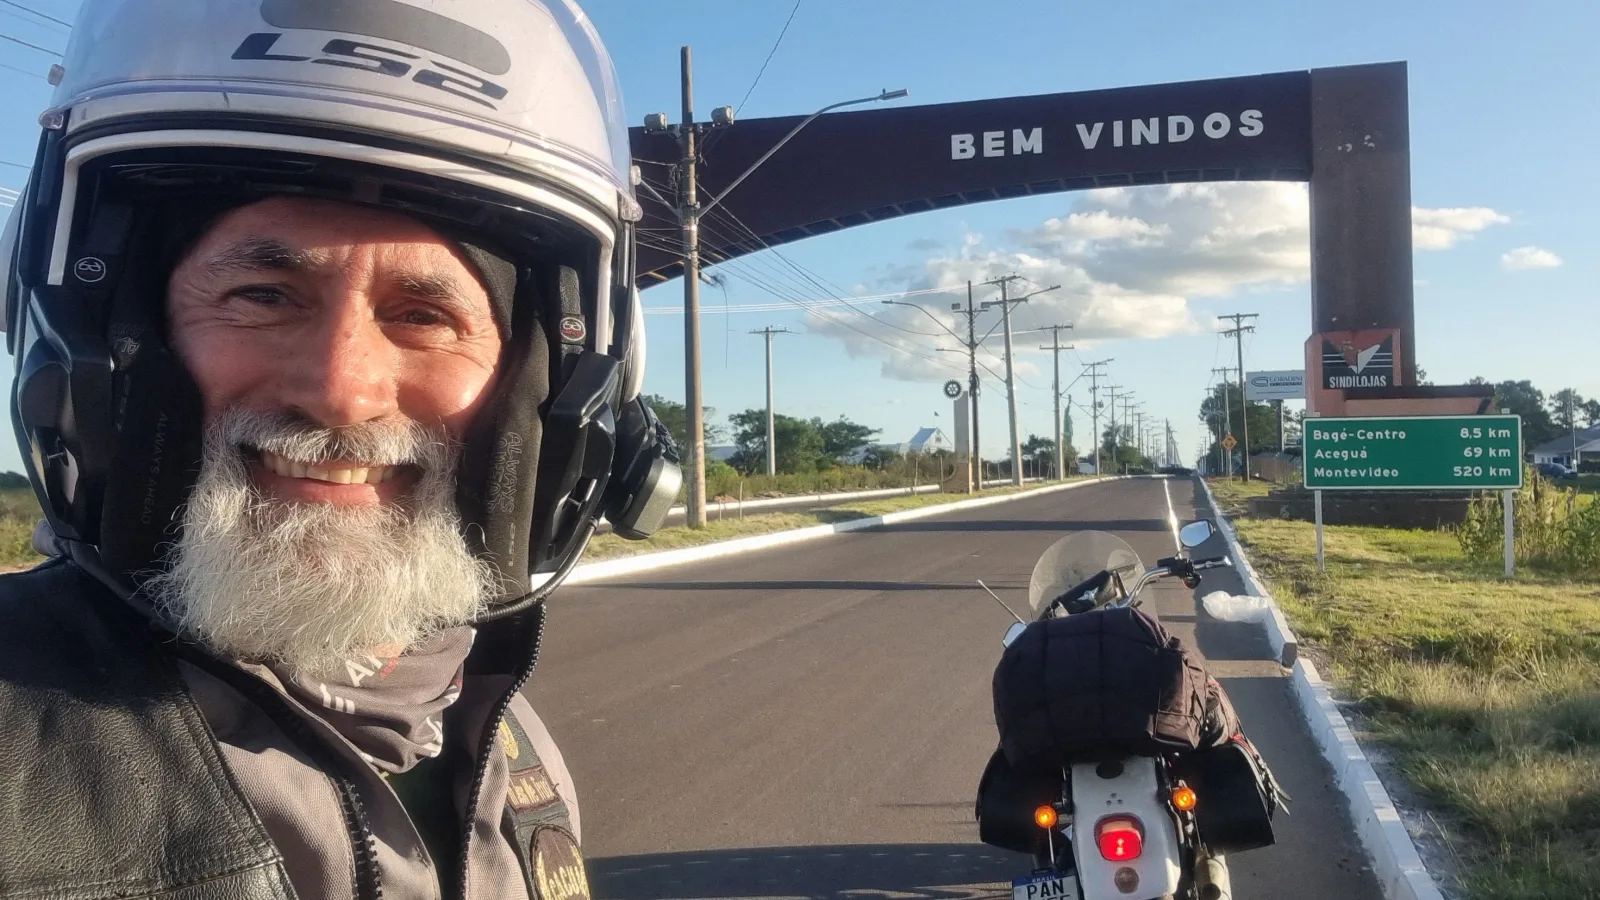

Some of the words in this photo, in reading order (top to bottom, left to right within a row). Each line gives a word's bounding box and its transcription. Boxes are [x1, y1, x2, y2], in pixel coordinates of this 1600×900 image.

[231, 33, 508, 111] LS2
[950, 127, 1043, 161] BEM
[1076, 109, 1264, 150] VINDOS
[1329, 375, 1387, 389] SINDILOJAS
[1313, 428, 1407, 443] Bagé-Centro
[1488, 427, 1511, 439] km
[1314, 446, 1368, 462] Aceguá
[1463, 447, 1483, 458] 69
[1488, 447, 1512, 458] km
[499, 431, 523, 513] ALWAYS
[1313, 467, 1399, 478] Montevideo
[1453, 466, 1483, 477] 520
[1489, 466, 1512, 477] km
[1031, 875, 1055, 883] BRASIL
[1026, 878, 1064, 900] PAN
